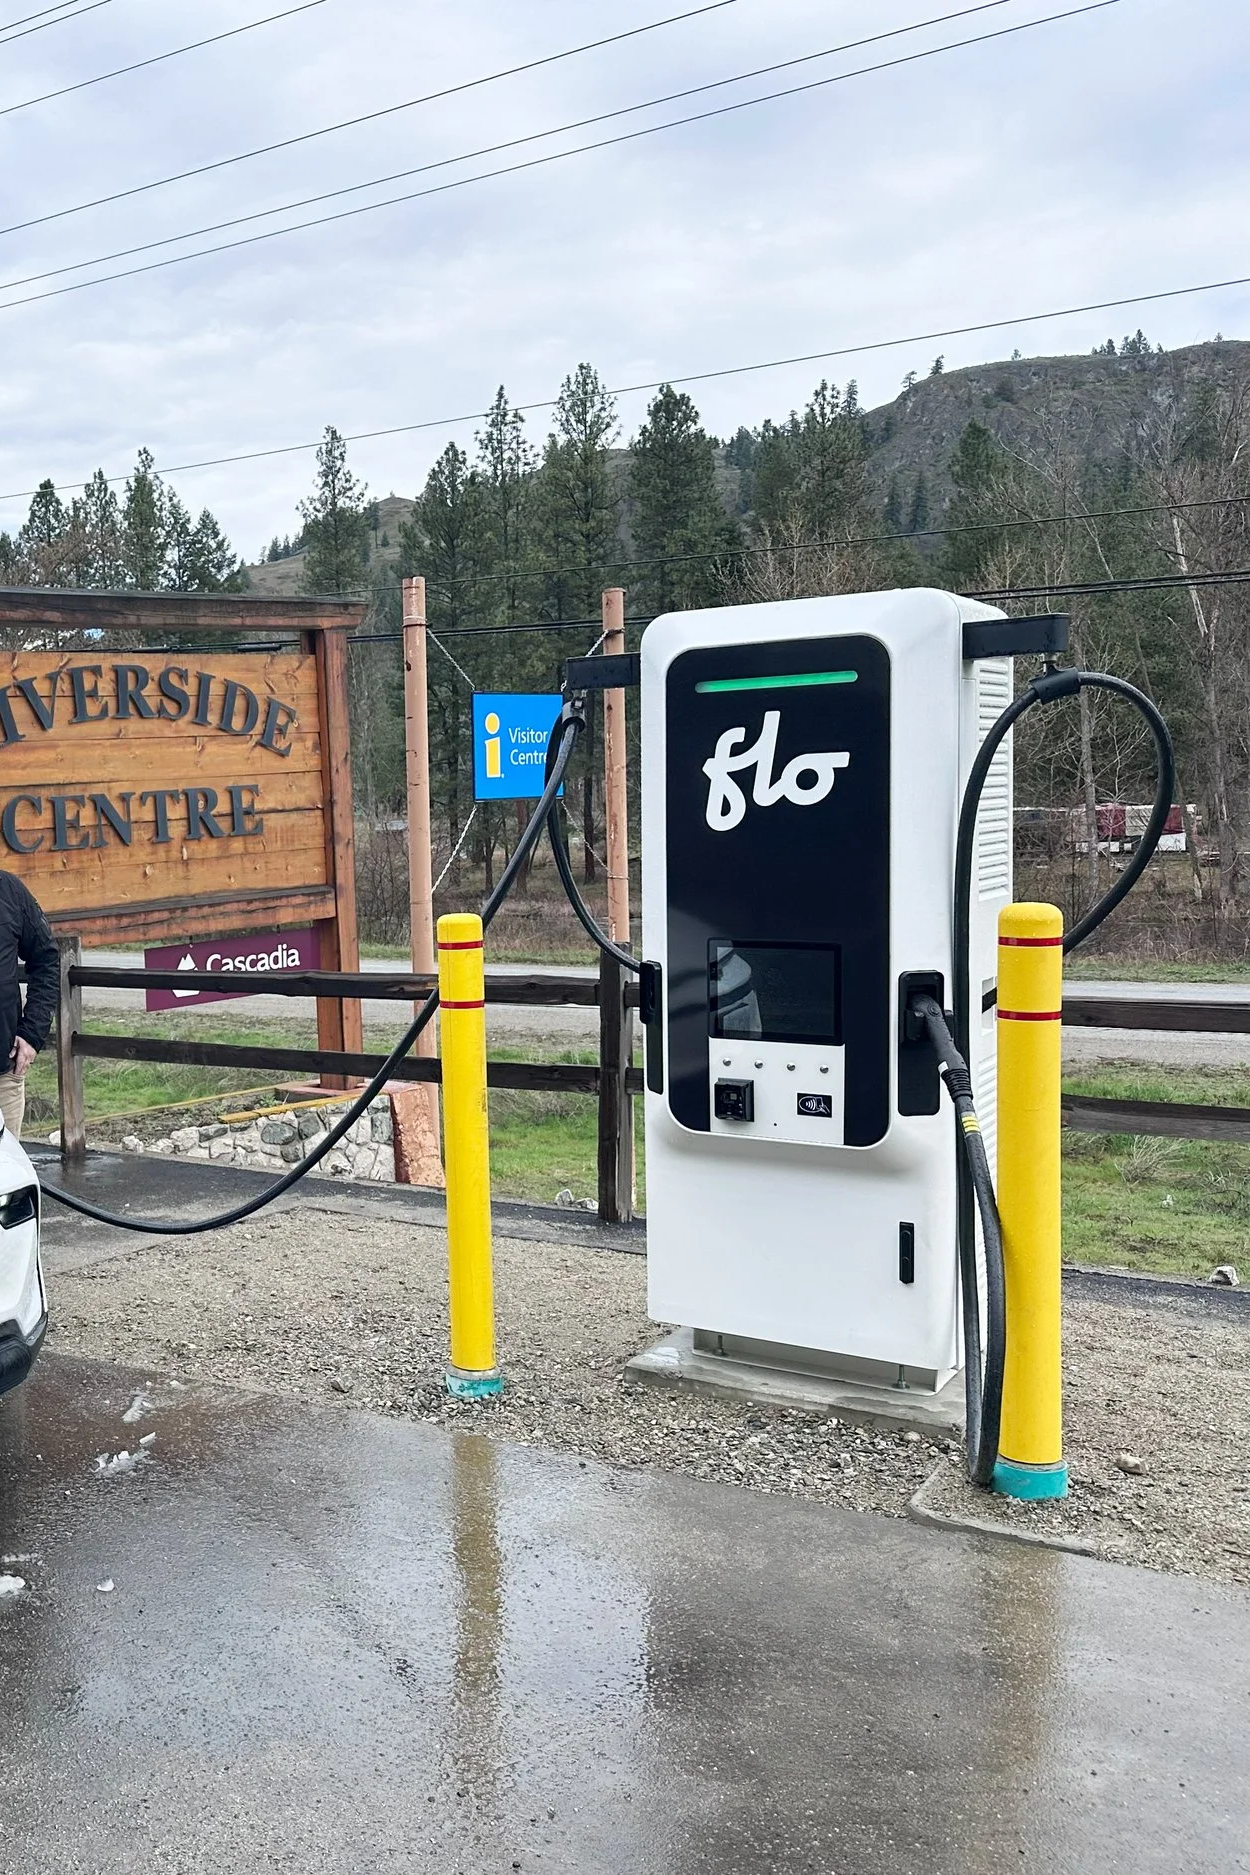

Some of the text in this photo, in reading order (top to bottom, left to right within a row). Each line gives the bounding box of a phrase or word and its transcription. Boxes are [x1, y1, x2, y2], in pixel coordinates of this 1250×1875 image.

[508, 727, 548, 744] Visitor
[702, 710, 851, 832] flo
[1, 783, 265, 854] CENTRE
[206, 943, 301, 971] Cascadia
